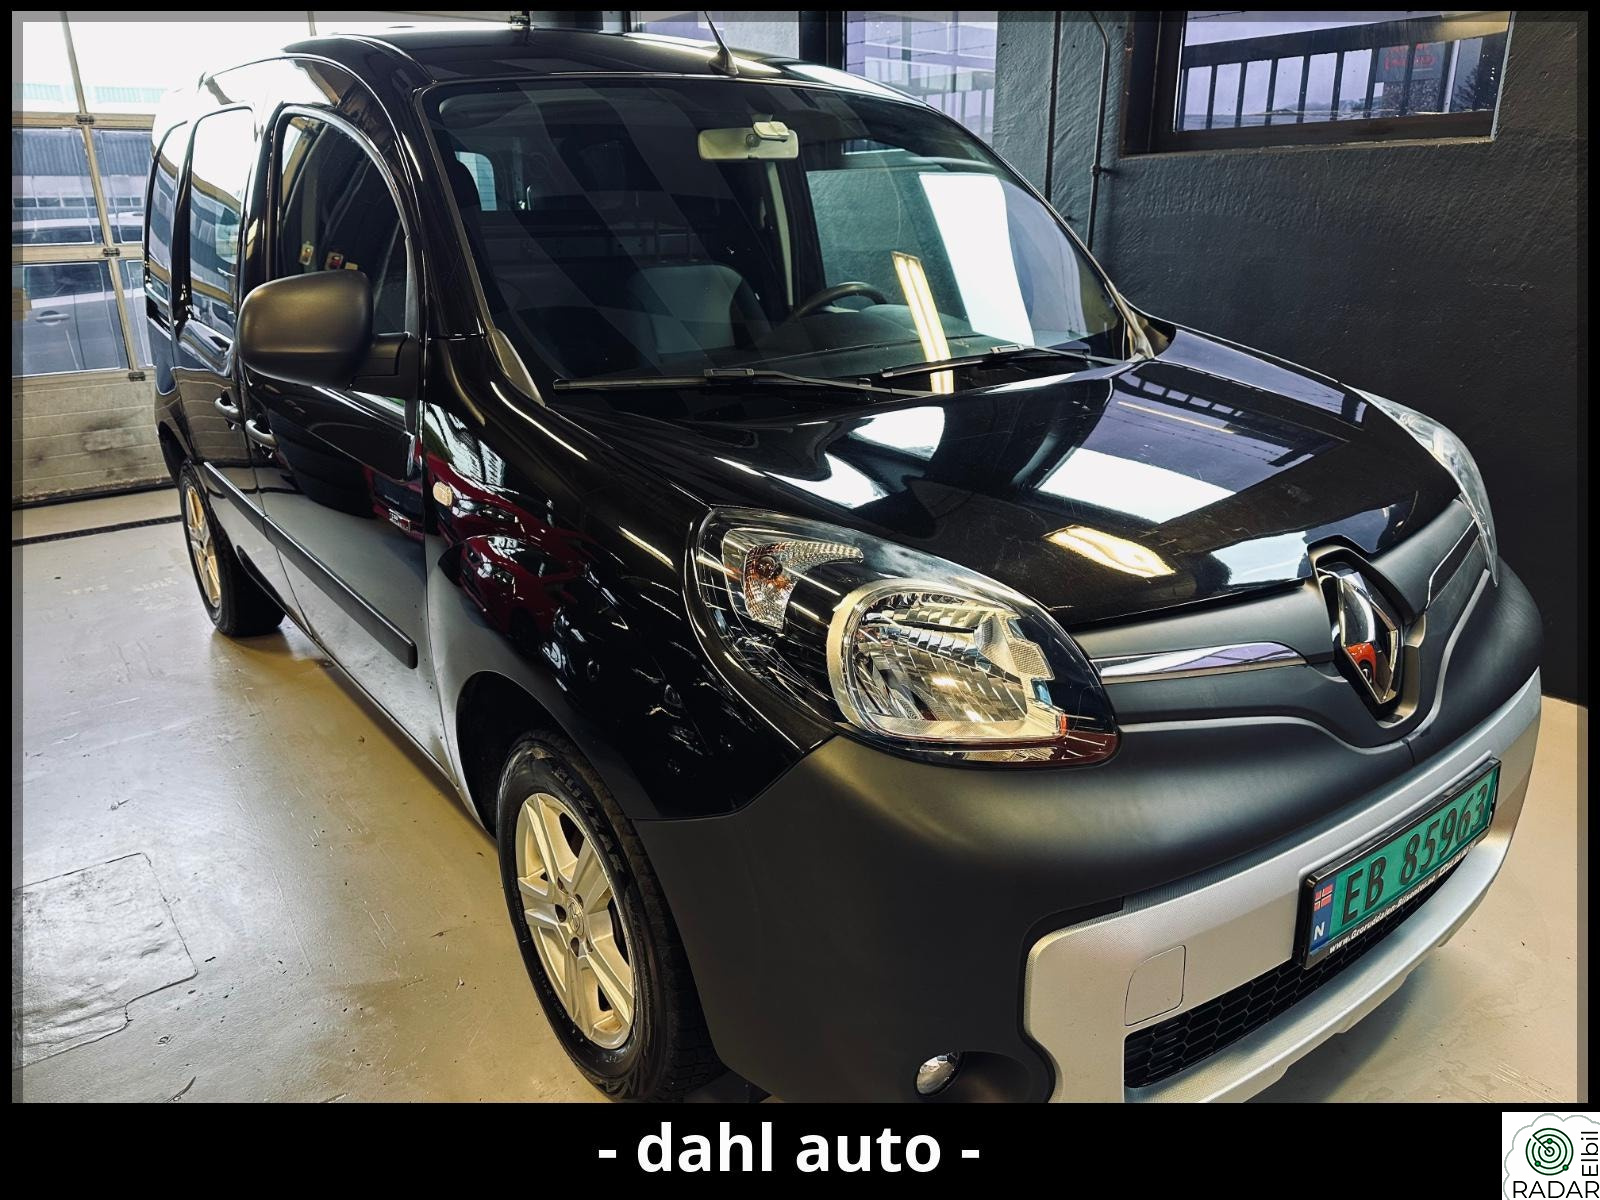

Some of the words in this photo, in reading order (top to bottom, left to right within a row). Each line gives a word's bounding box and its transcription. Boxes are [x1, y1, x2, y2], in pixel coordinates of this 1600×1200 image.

[1341, 855, 1387, 926] EB
[1399, 783, 1488, 886] 85963
[1313, 922, 1325, 941] N
